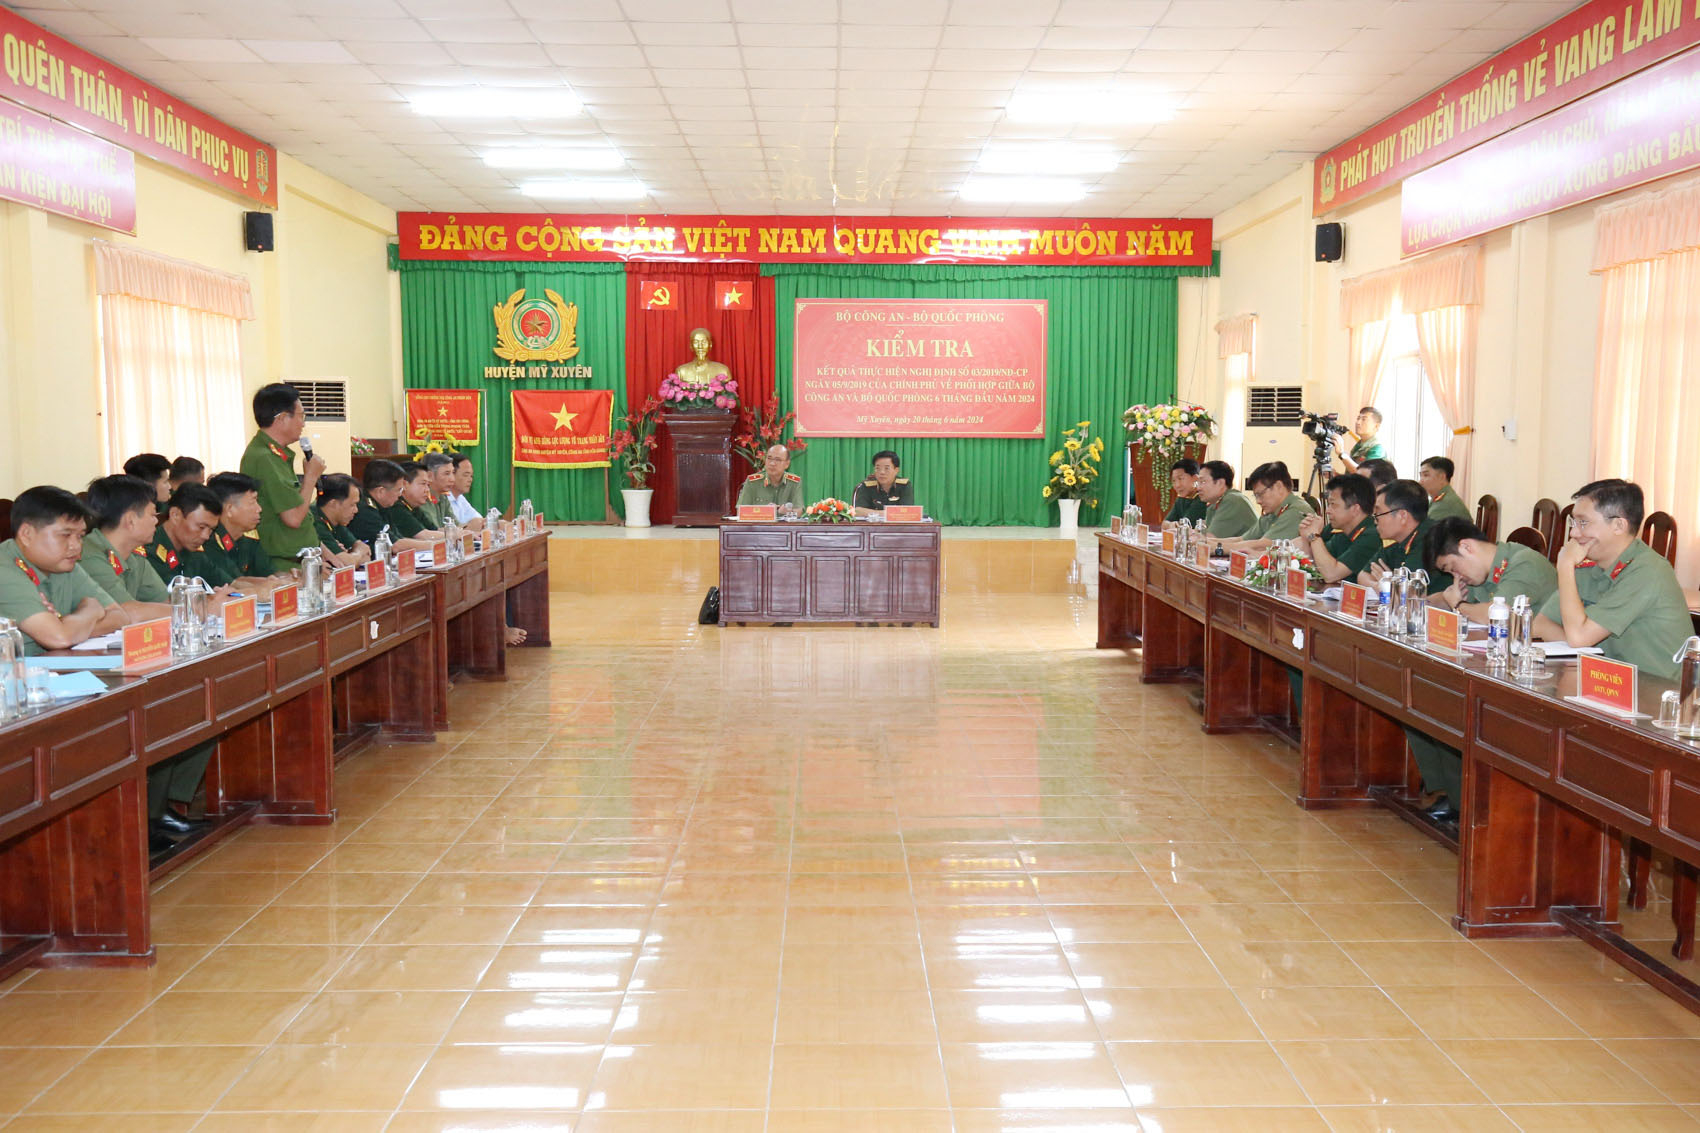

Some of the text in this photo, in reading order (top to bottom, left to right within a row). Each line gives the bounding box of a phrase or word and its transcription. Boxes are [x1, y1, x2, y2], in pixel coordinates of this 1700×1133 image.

[4, 32, 249, 188] QUÊN THÂN, VÌ DÂN PHỤC VỤ
[1340, 144, 1369, 192] PHÁT
[1371, 133, 1397, 177] HUY
[1460, 64, 1517, 133] THỐNG
[1523, 38, 1548, 102] VẺ
[1554, 16, 1616, 87] VANG
[88, 187, 112, 223] HỘI
[419, 215, 508, 252] ĐẢNG
[516, 218, 604, 258] CỘNG
[613, 217, 676, 252] SẢN
[682, 219, 751, 259] VIỆT
[758, 228, 826, 254] NAM
[834, 228, 940, 256] QUANG
[1029, 223, 1117, 256] MUÔN
[1126, 223, 1194, 256] NĂM
[836, 309, 851, 323] BỘ
[854, 309, 886, 322] CÔNG
[888, 312, 905, 322] AN
[913, 309, 928, 323] BỘ
[931, 307, 963, 323] QUỐC
[966, 309, 1005, 323] PHÒNG
[866, 329, 975, 358] KIỂM TRA
[484, 364, 593, 381] HUYỆN MỸ XUYÊN
[816, 364, 836, 377] KẾT
[859, 367, 884, 378] THỰC
[885, 366, 908, 378] HIỆN
[958, 364, 970, 377] SỐ
[889, 379, 919, 389] CHÍNH
[1022, 379, 1036, 391] BỘ
[804, 391, 831, 402] CÔNG
[831, 394, 846, 402] AN
[846, 391, 860, 402] VÀ
[874, 390, 901, 403] QUỐC
[902, 391, 934, 403] PHÒNG
[942, 391, 973, 403] THÁNG
[995, 391, 1017, 403] NĂM
[1018, 394, 1036, 403] 2024
[966, 416, 984, 424] 2024
